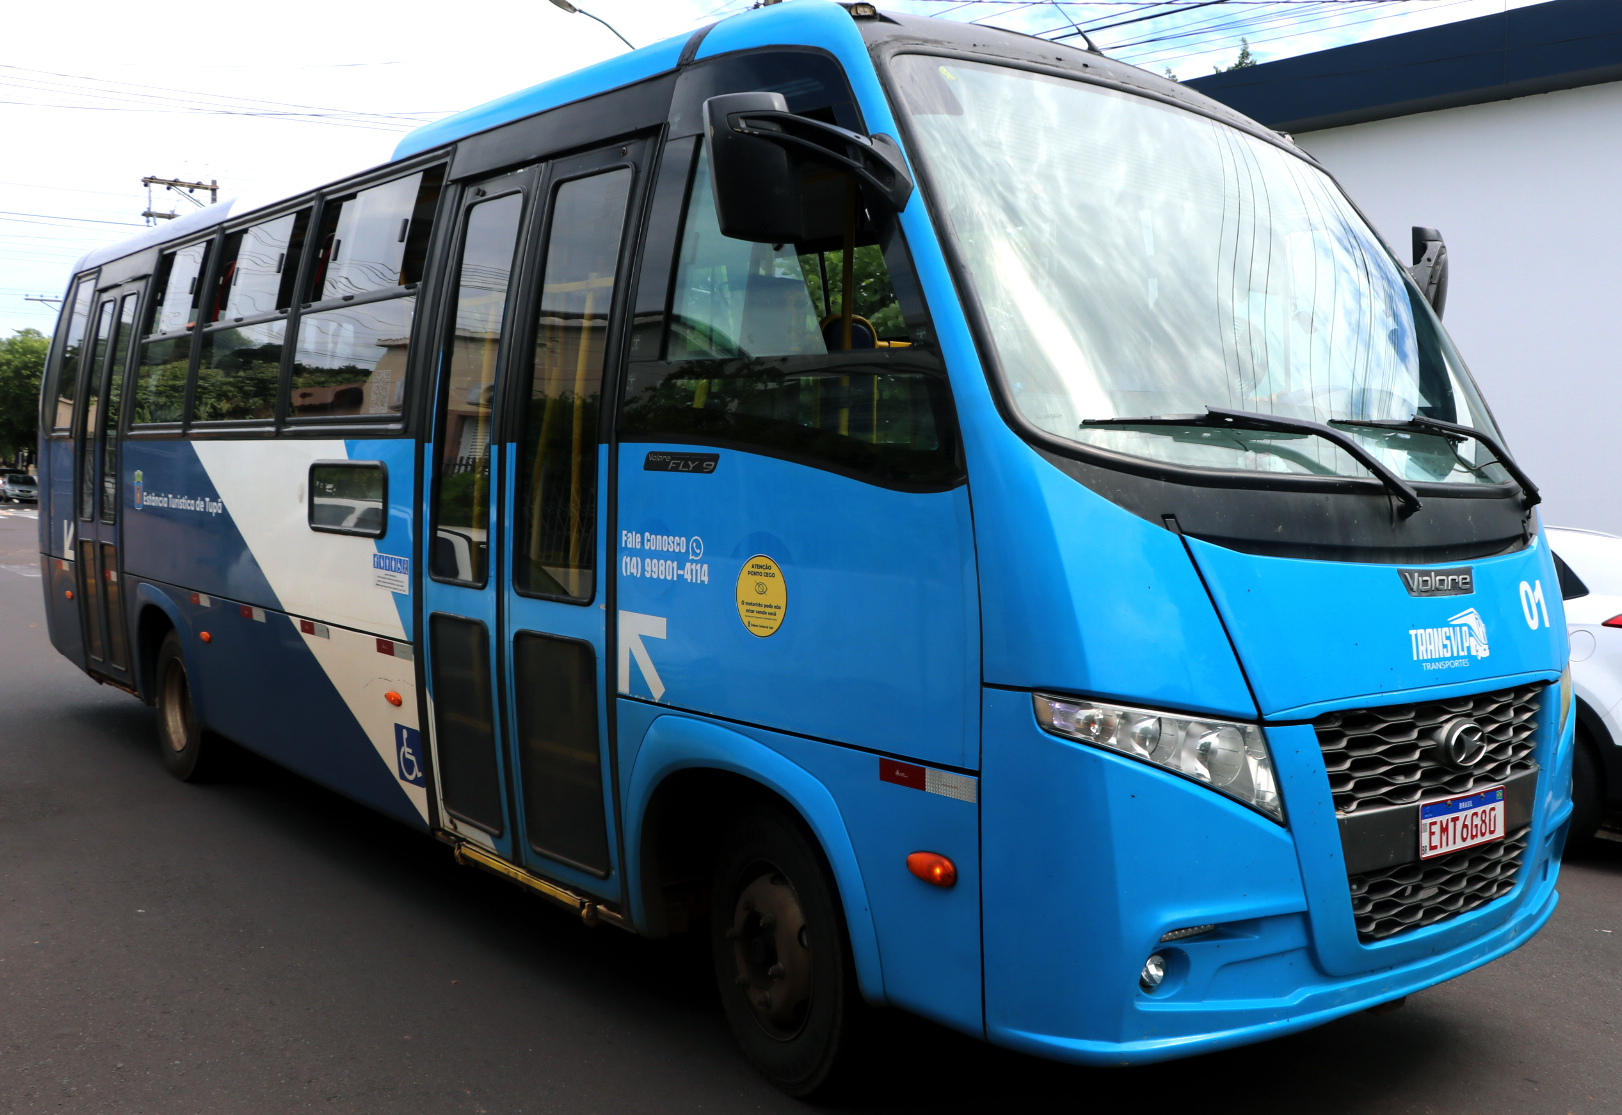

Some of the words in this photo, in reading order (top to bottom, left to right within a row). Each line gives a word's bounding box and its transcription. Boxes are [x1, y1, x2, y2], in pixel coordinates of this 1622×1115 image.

[668, 461, 699, 471] FLY
[703, 461, 715, 472] 9
[143, 492, 168, 507] Estância
[168, 493, 195, 511] Turística
[195, 496, 205, 512] de
[205, 497, 222, 516] Tupã
[622, 530, 642, 549] Fale
[644, 532, 686, 553] Conosco
[622, 556, 642, 578] (14)
[644, 558, 709, 584] 99801-4114
[1404, 572, 1471, 592] Volare
[1519, 580, 1550, 630] 01
[1409, 626, 1470, 660] TRANSVLP
[1422, 658, 1470, 671] TRANSPORTES
[1459, 800, 1473, 810] BRASIL
[1429, 806, 1497, 851] EMT6G80
